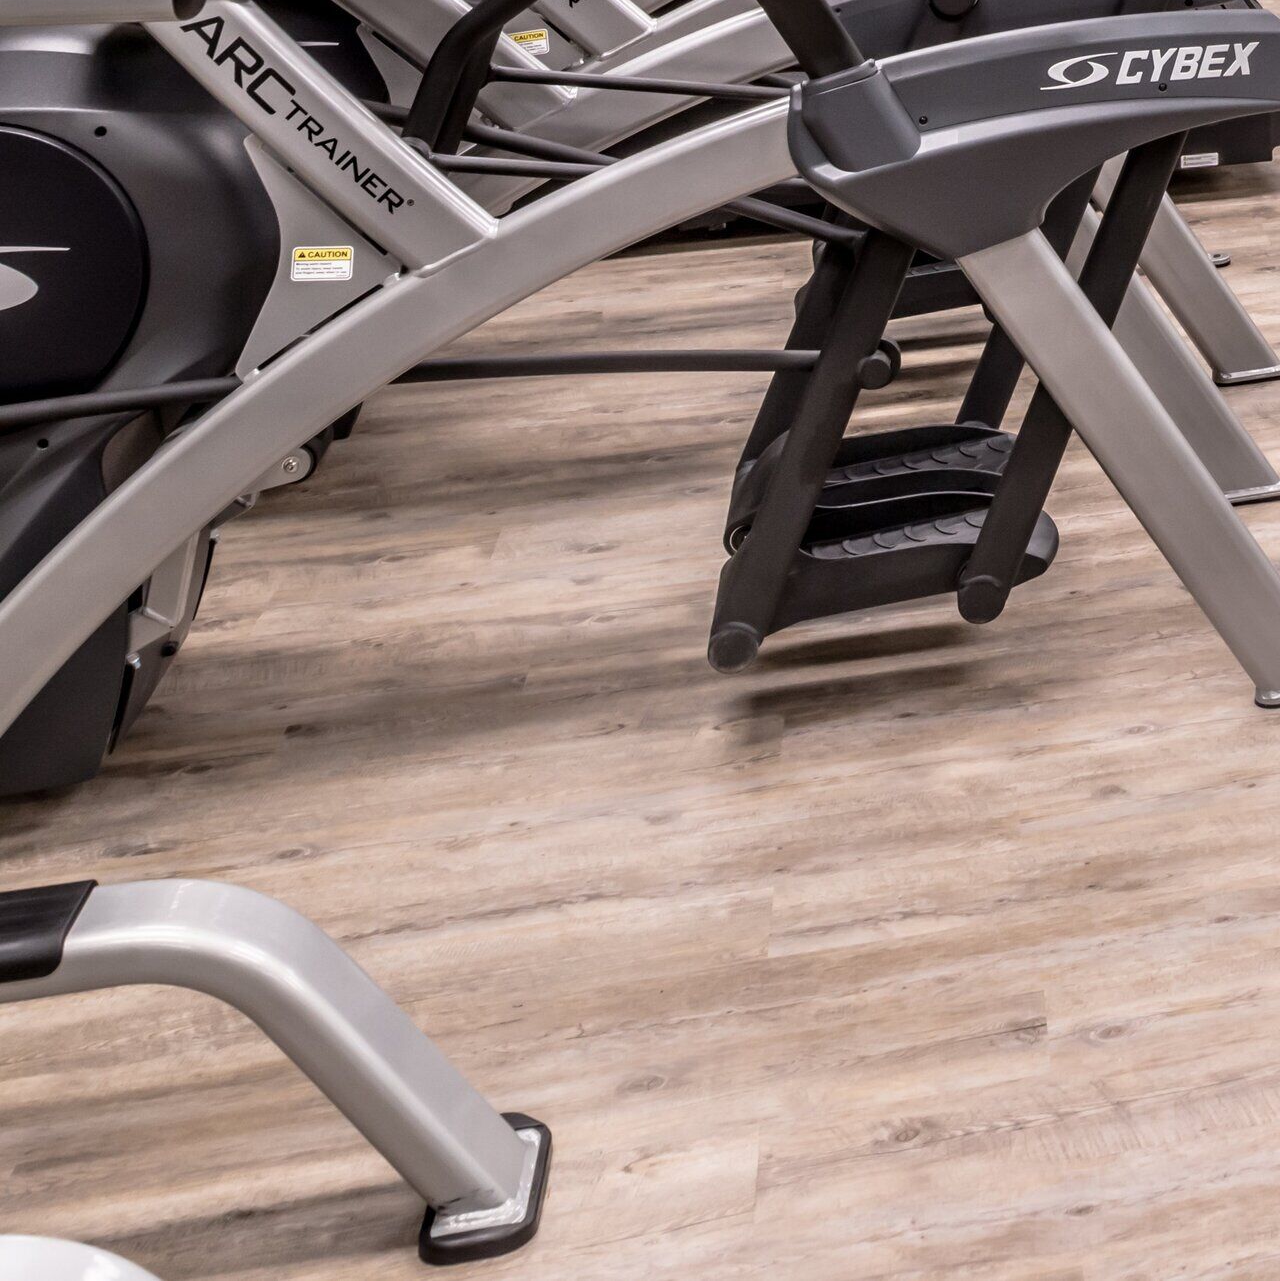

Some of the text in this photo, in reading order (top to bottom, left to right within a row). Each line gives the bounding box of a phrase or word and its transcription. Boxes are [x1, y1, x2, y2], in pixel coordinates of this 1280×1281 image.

[514, 32, 544, 41] CAUTION
[180, 16, 296, 115] ARC
[1115, 41, 1260, 85] CYBEX
[308, 250, 348, 258] CAUTION
